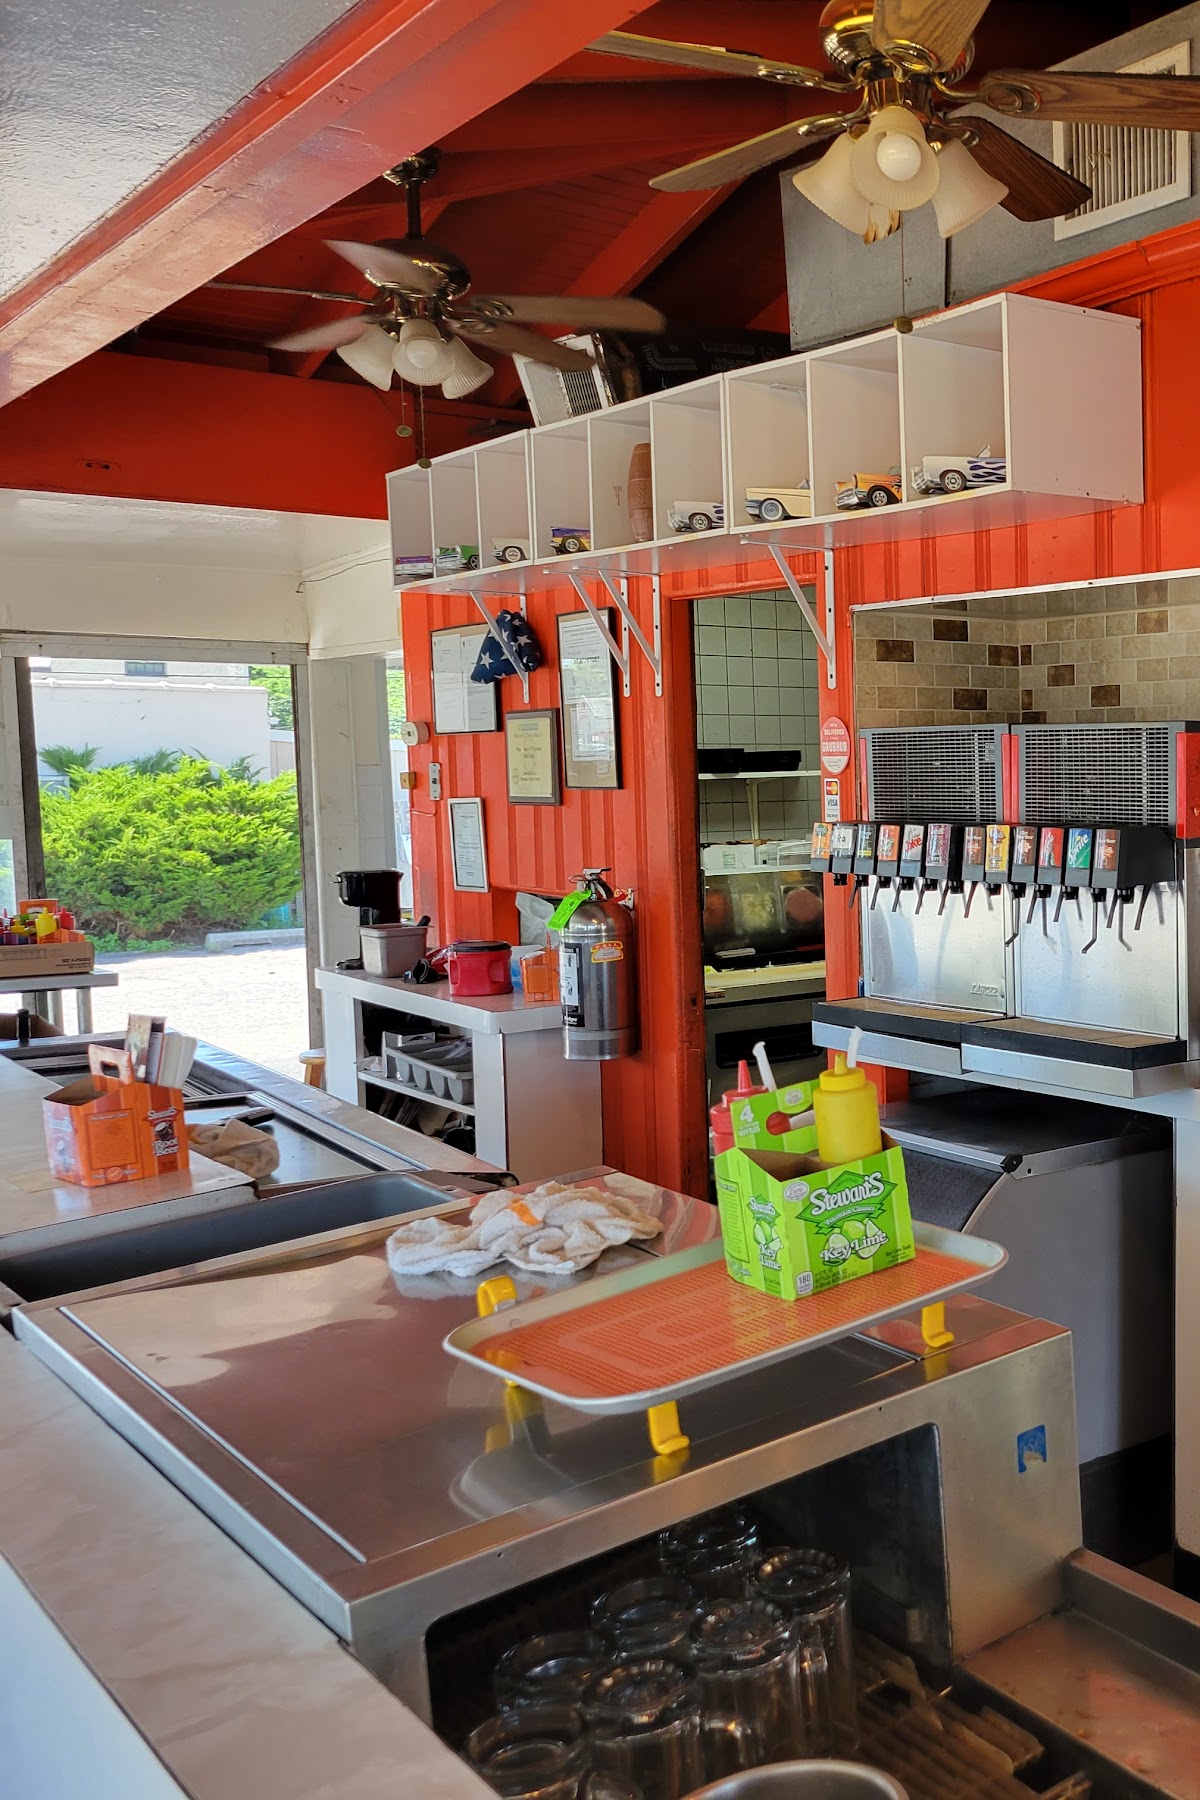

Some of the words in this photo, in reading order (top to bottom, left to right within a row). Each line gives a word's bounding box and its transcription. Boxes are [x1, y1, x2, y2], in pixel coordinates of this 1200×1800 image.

[1068, 833, 1090, 864] Sprite
[740, 1104, 755, 1122] 4
[152, 1137, 179, 1149] Root
[153, 1146, 179, 1157] Beer
[759, 1242, 778, 1260] Key
[820, 1243, 851, 1262] Key
[850, 1229, 889, 1252] Lime
